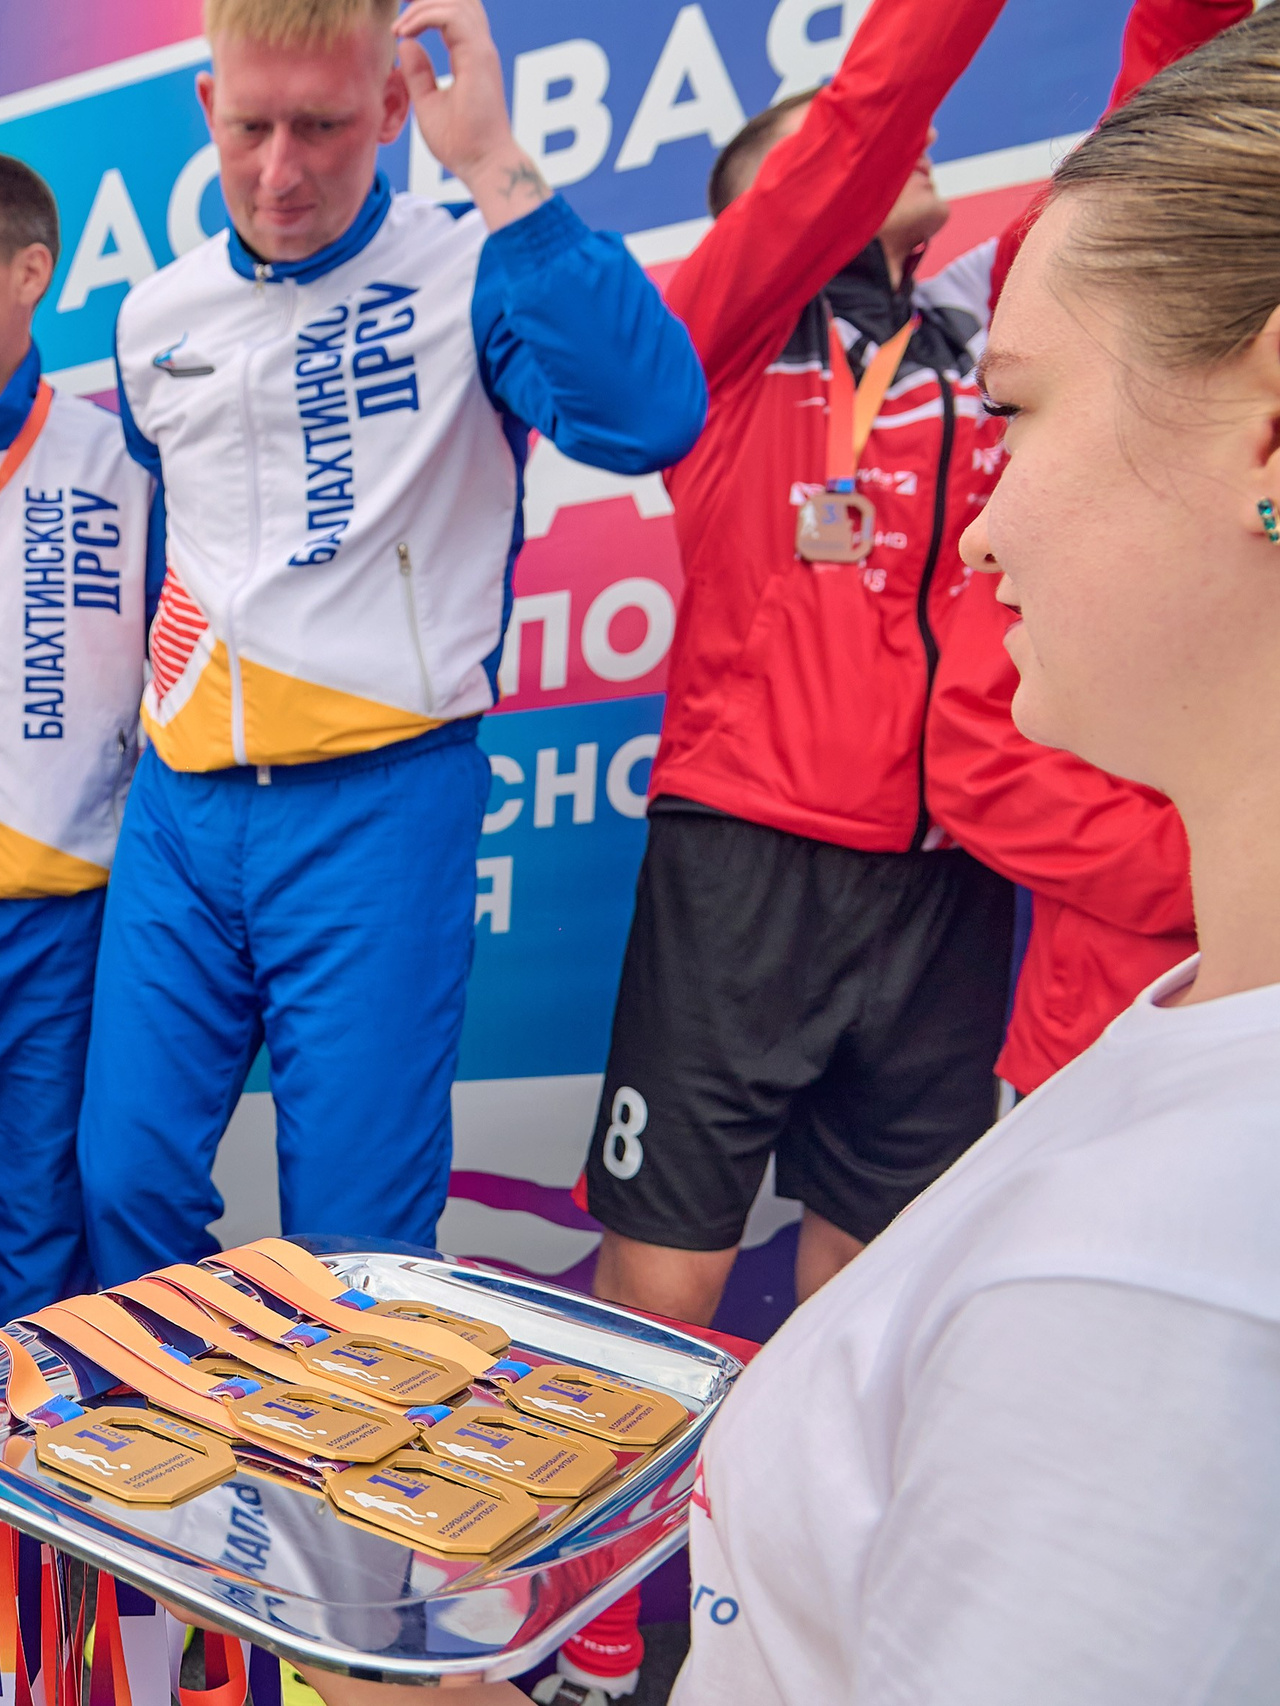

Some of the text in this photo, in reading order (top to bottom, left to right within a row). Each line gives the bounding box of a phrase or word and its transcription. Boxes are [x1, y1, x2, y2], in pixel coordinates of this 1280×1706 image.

[352, 281, 420, 419] ДРСУ
[71, 488, 121, 615] ДРСУ
[23, 487, 65, 740] БАЛАХТИНСКОЕ
[603, 1086, 648, 1180] 8
[331, 1349, 378, 1367] 1
[342, 1345, 384, 1363] МЕСТО
[538, 1384, 590, 1403] 1
[548, 1379, 593, 1398] МЕСТО
[263, 1402, 317, 1420] 1
[275, 1397, 320, 1414] МЕСТО
[92, 1424, 136, 1444] МЕСТО
[153, 1417, 202, 1439] 2024
[467, 1422, 515, 1443] МЕСТО
[518, 1416, 571, 1437] 2024
[74, 1430, 130, 1452] 1
[454, 1428, 509, 1450] 1
[129, 1453, 186, 1482] СОРЕВНОВАНИЯХ
[144, 1457, 195, 1486] МИНИ-ФУТБОЛУ
[438, 1459, 494, 1484] 2024
[366, 1474, 425, 1499] 1
[381, 1468, 431, 1491] МЕСТО
[442, 1499, 487, 1533] СОРЕВНОВАНИЯХ
[458, 1503, 498, 1537] МИНИ-ФУТБОЛУ
